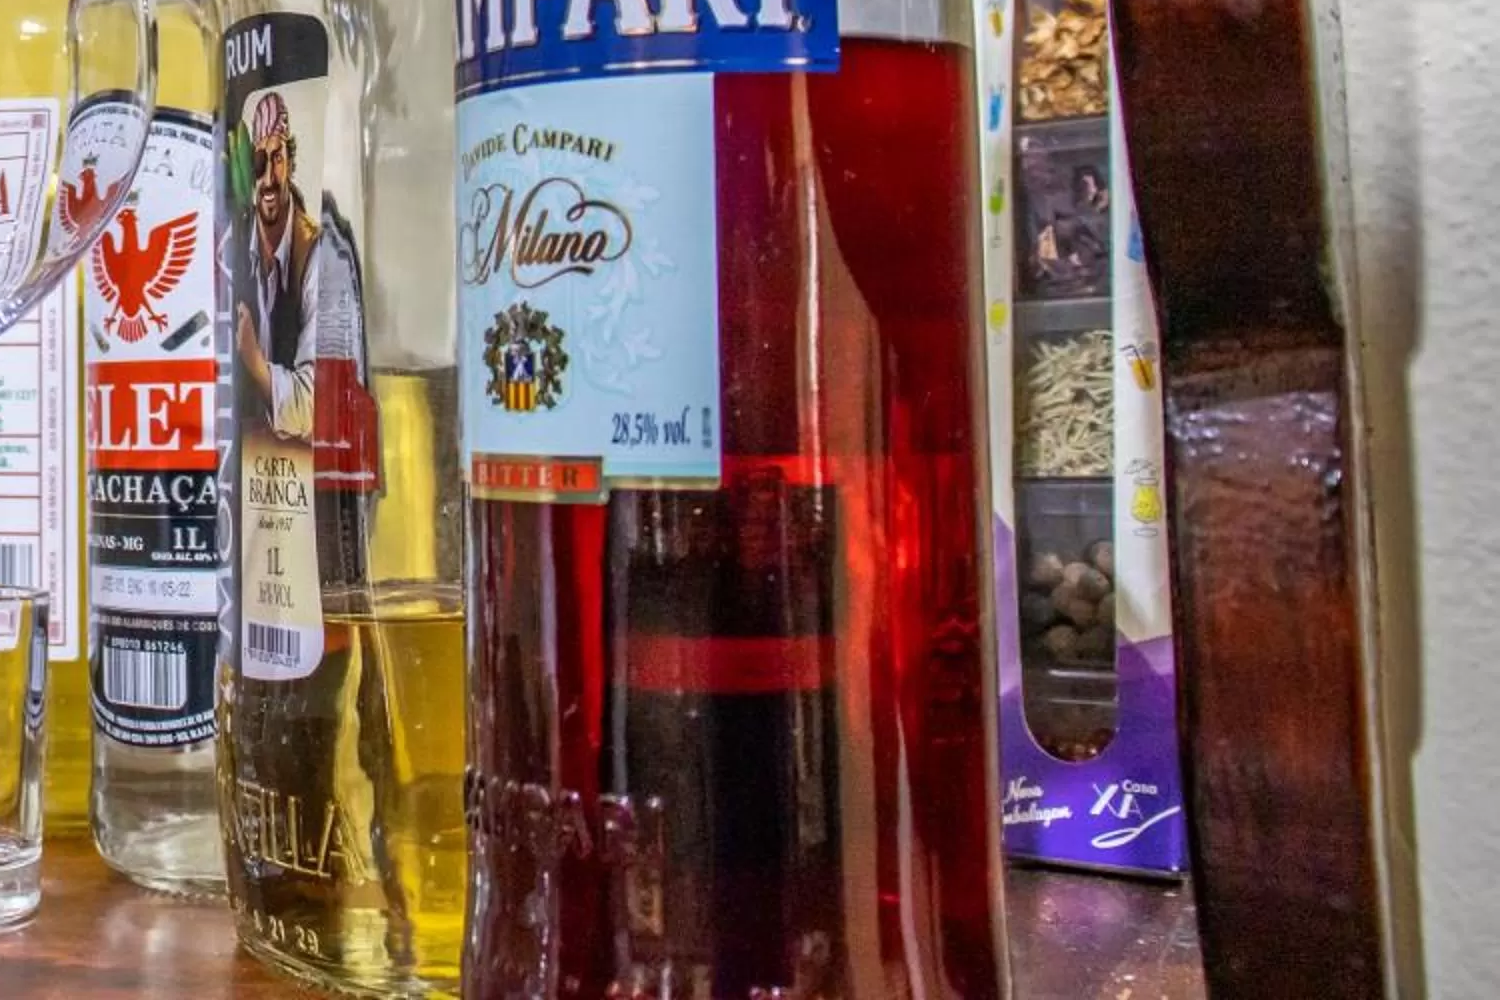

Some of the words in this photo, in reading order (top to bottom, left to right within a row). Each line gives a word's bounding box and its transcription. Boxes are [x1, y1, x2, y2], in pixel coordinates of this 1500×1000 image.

[225, 23, 274, 80] RUM
[512, 122, 618, 163] CAMPARI
[460, 177, 633, 289] Milano
[663, 406, 692, 446] vol.
[255, 456, 297, 479] CARTA
[477, 461, 580, 490] BITTER
[249, 478, 308, 507] BRANCA
